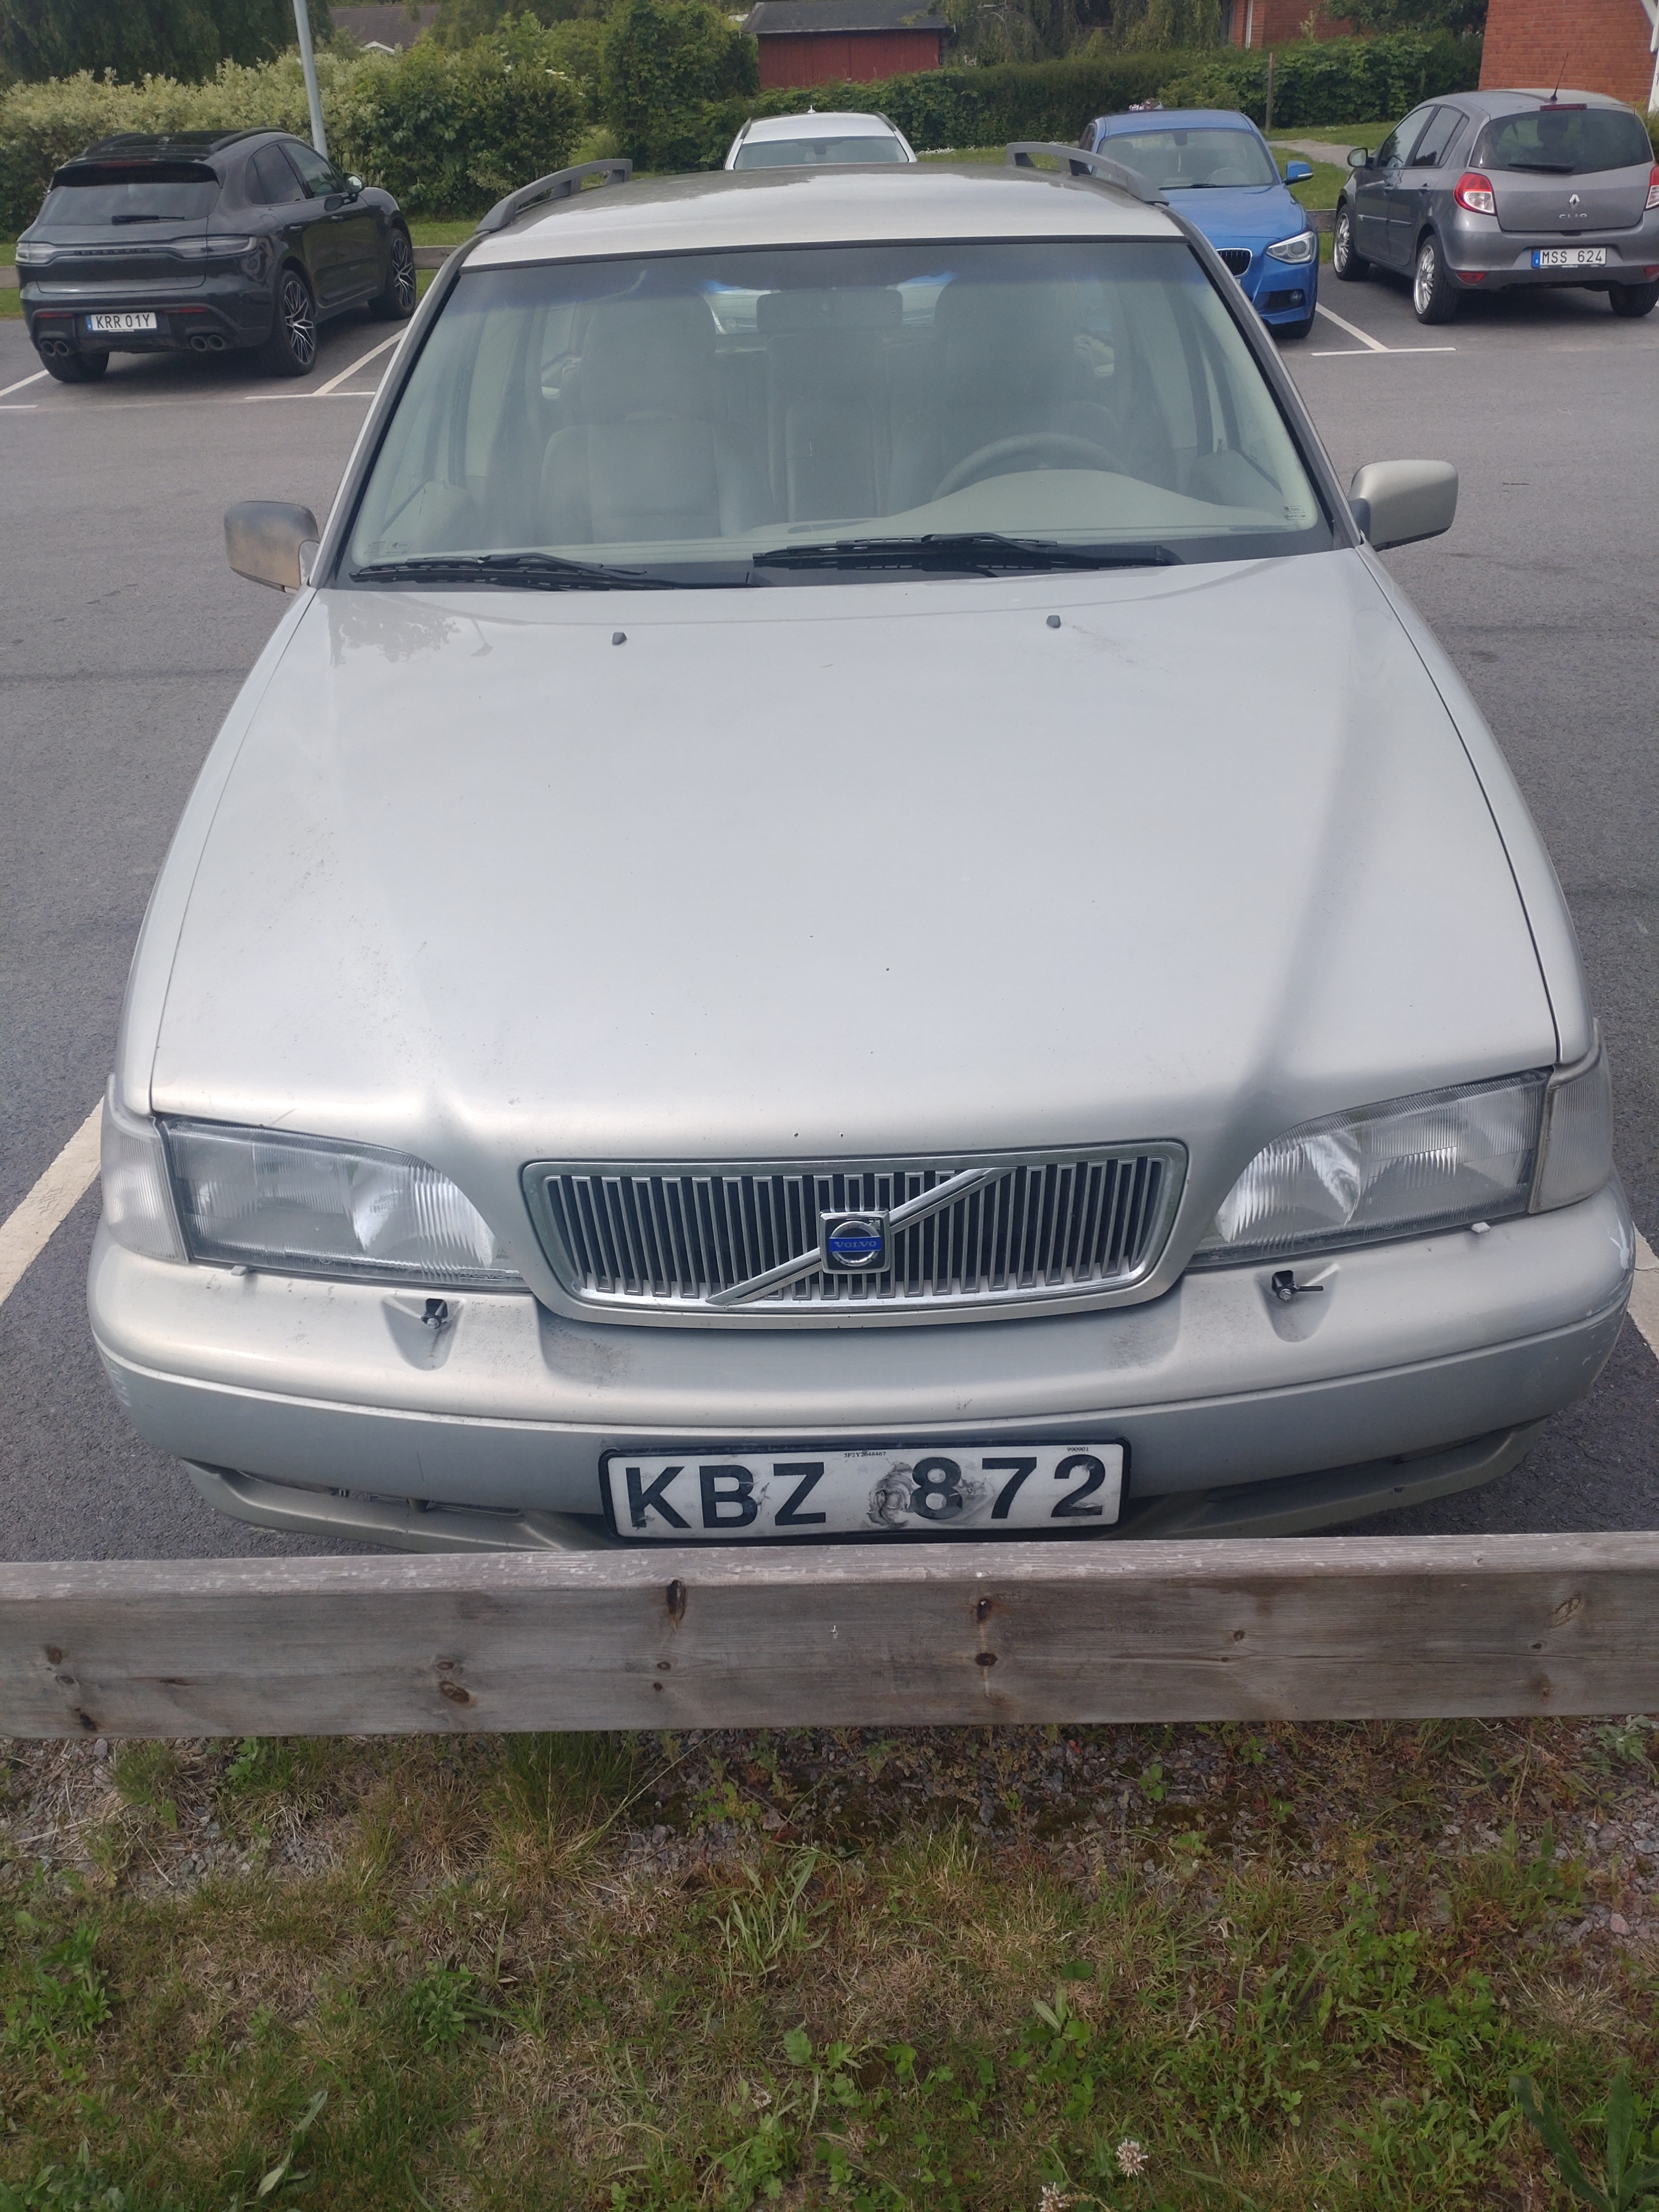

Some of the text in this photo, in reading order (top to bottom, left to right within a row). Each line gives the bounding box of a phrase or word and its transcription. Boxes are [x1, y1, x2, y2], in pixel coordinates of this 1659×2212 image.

[1542, 250, 1602, 264] MSS 624
[96, 314, 149, 329] KRR 01Y
[625, 1454, 1105, 1528] KBZ 872
